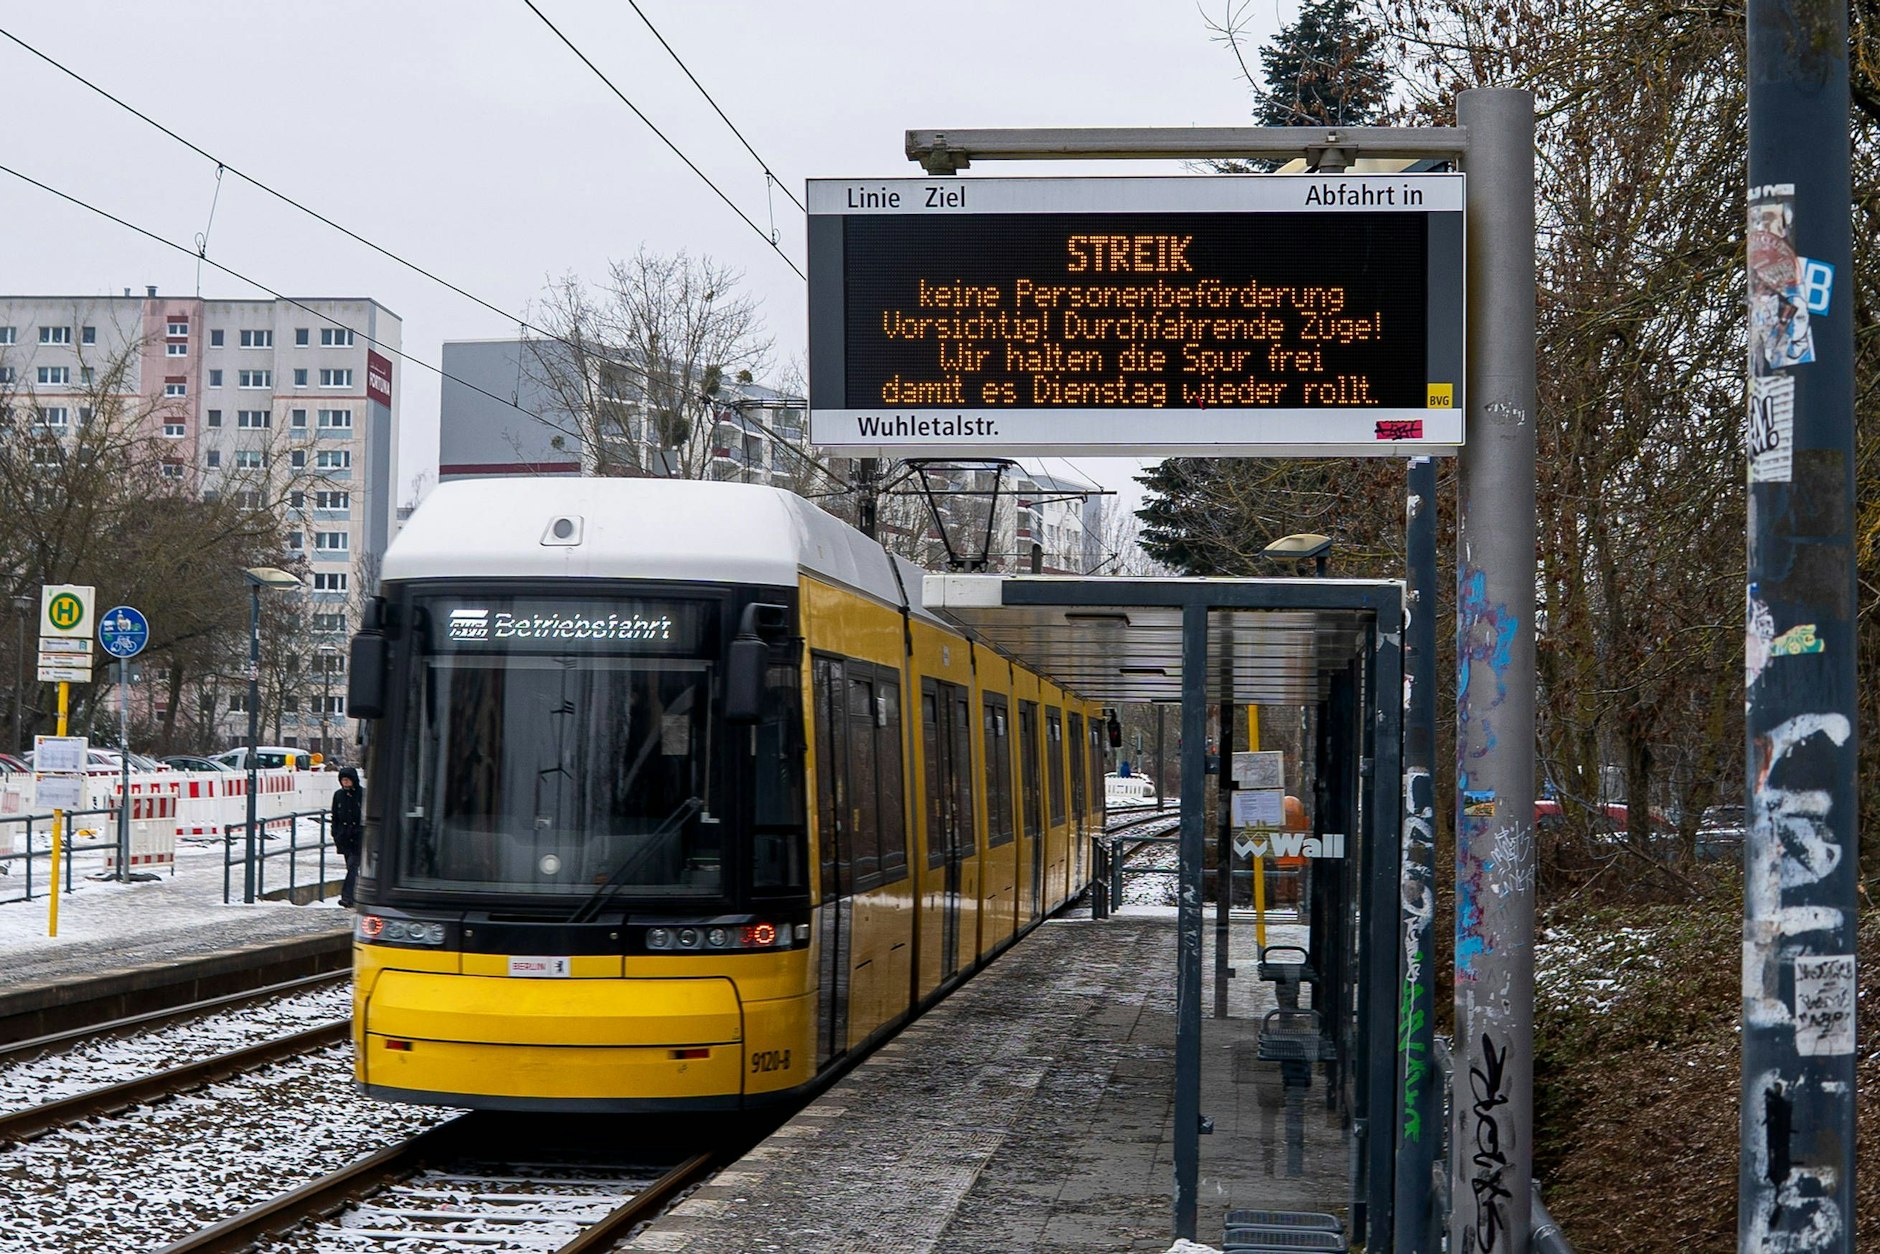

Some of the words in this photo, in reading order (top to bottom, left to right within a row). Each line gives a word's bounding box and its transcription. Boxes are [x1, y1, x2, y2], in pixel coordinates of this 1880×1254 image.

[848, 186, 901, 209] Linie
[925, 185, 966, 208] Ziel
[1305, 183, 1395, 206] Abfahrt
[1403, 184, 1423, 205] in
[1068, 235, 1193, 272] STREIK
[920, 279, 999, 307] keine
[1016, 279, 1344, 312] Personenbeförderung
[883, 311, 1048, 343] Vorsichtig!
[1065, 311, 1284, 340] Durchfahrende
[1300, 311, 1381, 344] Züge!
[940, 342, 990, 371] Wir
[1006, 342, 1102, 371] halten
[1119, 342, 1166, 371] die
[1183, 343, 1251, 375] Spur
[1268, 343, 1324, 371] frei
[882, 374, 965, 403] damit
[982, 382, 1017, 403] es
[1033, 374, 1167, 407] Dienstag
[1183, 375, 1288, 404] wieder
[1304, 375, 1379, 404] rollt.
[1429, 395, 1450, 406] BVG
[858, 414, 999, 437] Wuhletalstr.
[57, 601, 74, 622] H
[494, 612, 672, 640] Betriebsfahrt
[1269, 832, 1345, 859] Wall
[512, 961, 547, 971] BERLIN
[751, 1049, 791, 1074] 9120-B
